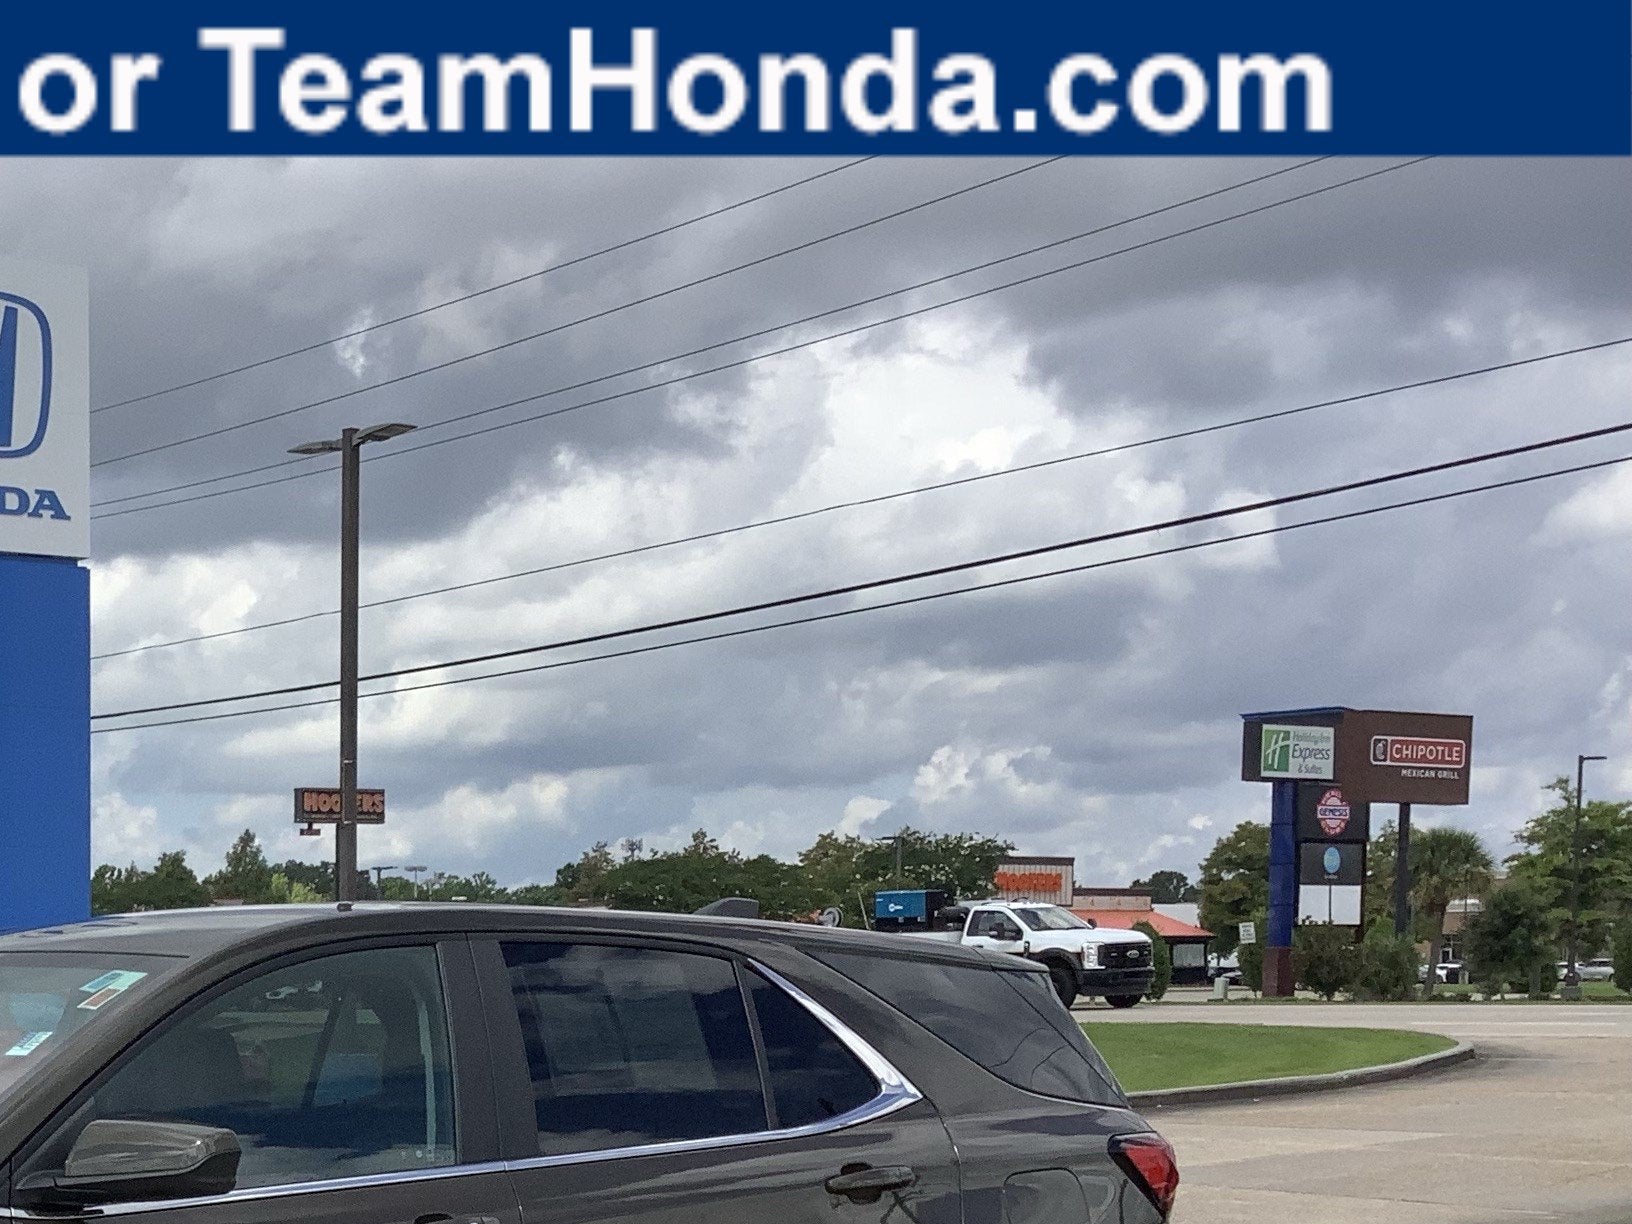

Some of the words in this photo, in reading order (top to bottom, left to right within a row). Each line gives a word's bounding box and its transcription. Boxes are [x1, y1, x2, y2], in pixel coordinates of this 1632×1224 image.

[1291, 743, 1331, 762] Express
[1392, 743, 1461, 761] CHIPOTLE
[1401, 768, 1436, 778] MEXICAN
[1437, 769, 1460, 780] GRILL
[303, 792, 384, 813] HOOERS
